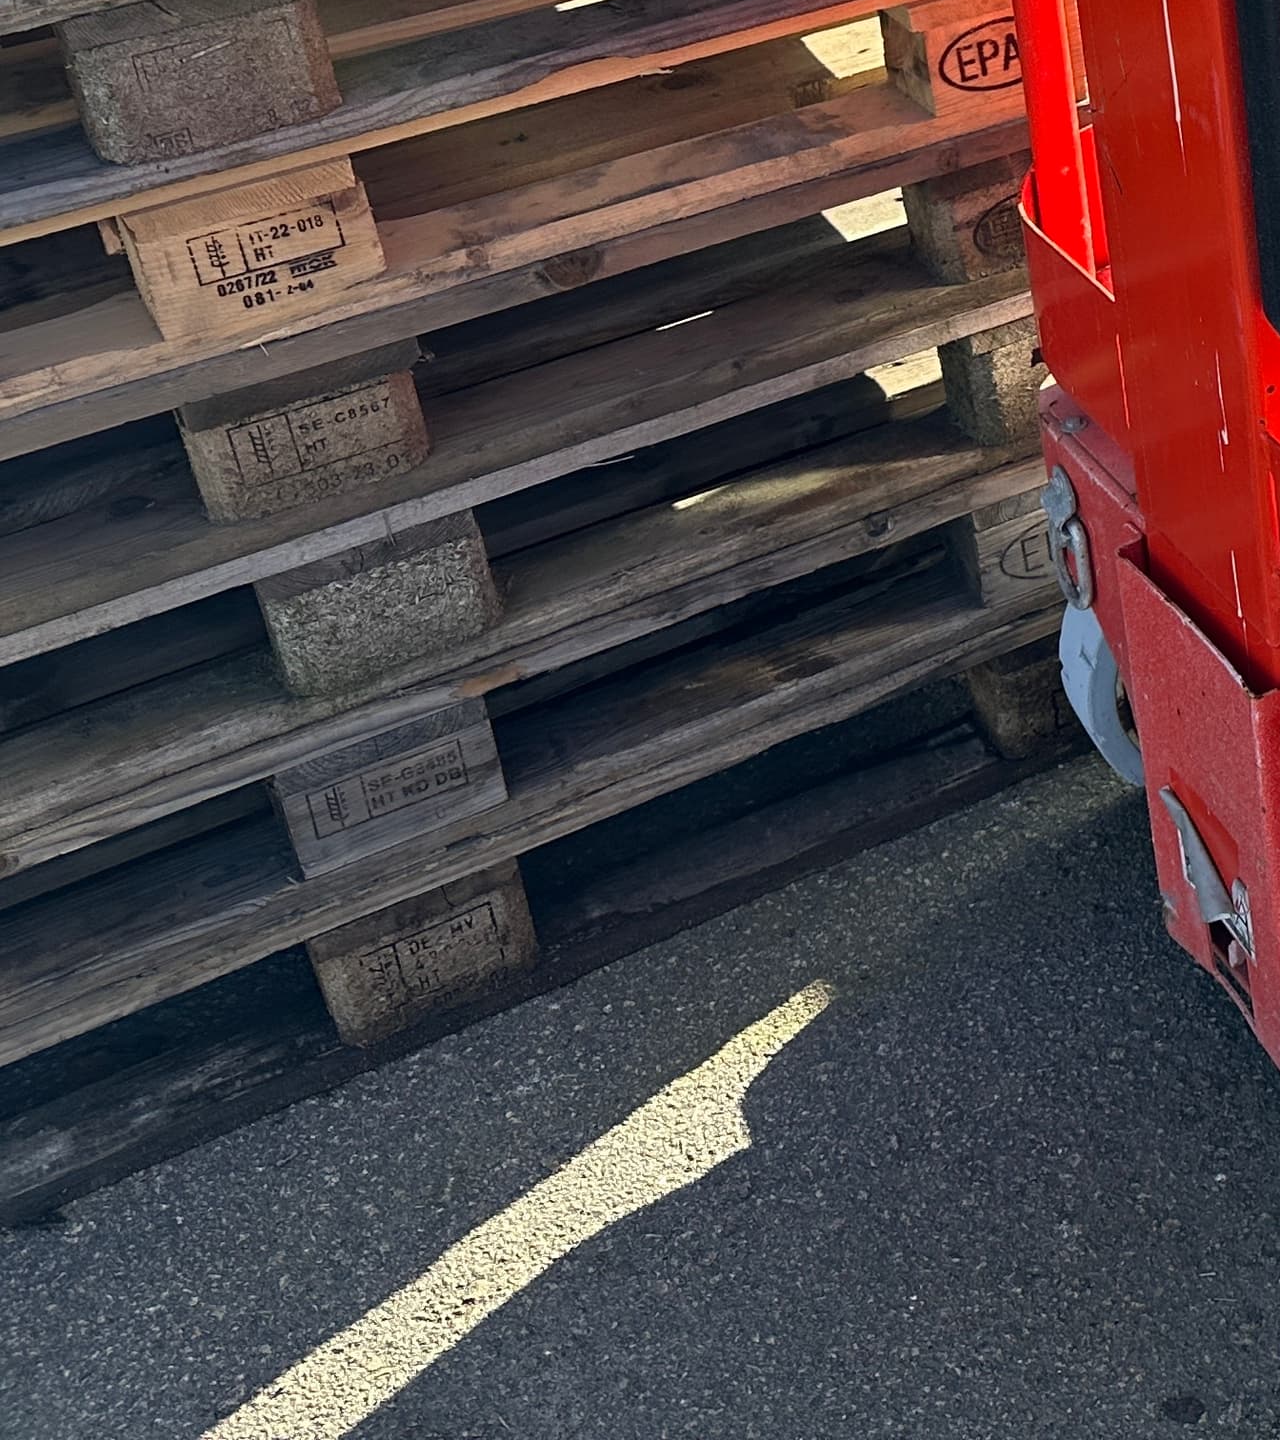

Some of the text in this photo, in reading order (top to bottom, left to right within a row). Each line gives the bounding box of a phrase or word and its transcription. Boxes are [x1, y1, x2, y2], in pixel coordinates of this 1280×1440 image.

[955, 32, 1020, 83] EPA
[252, 244, 275, 263] HT
[304, 436, 329, 454] HT
